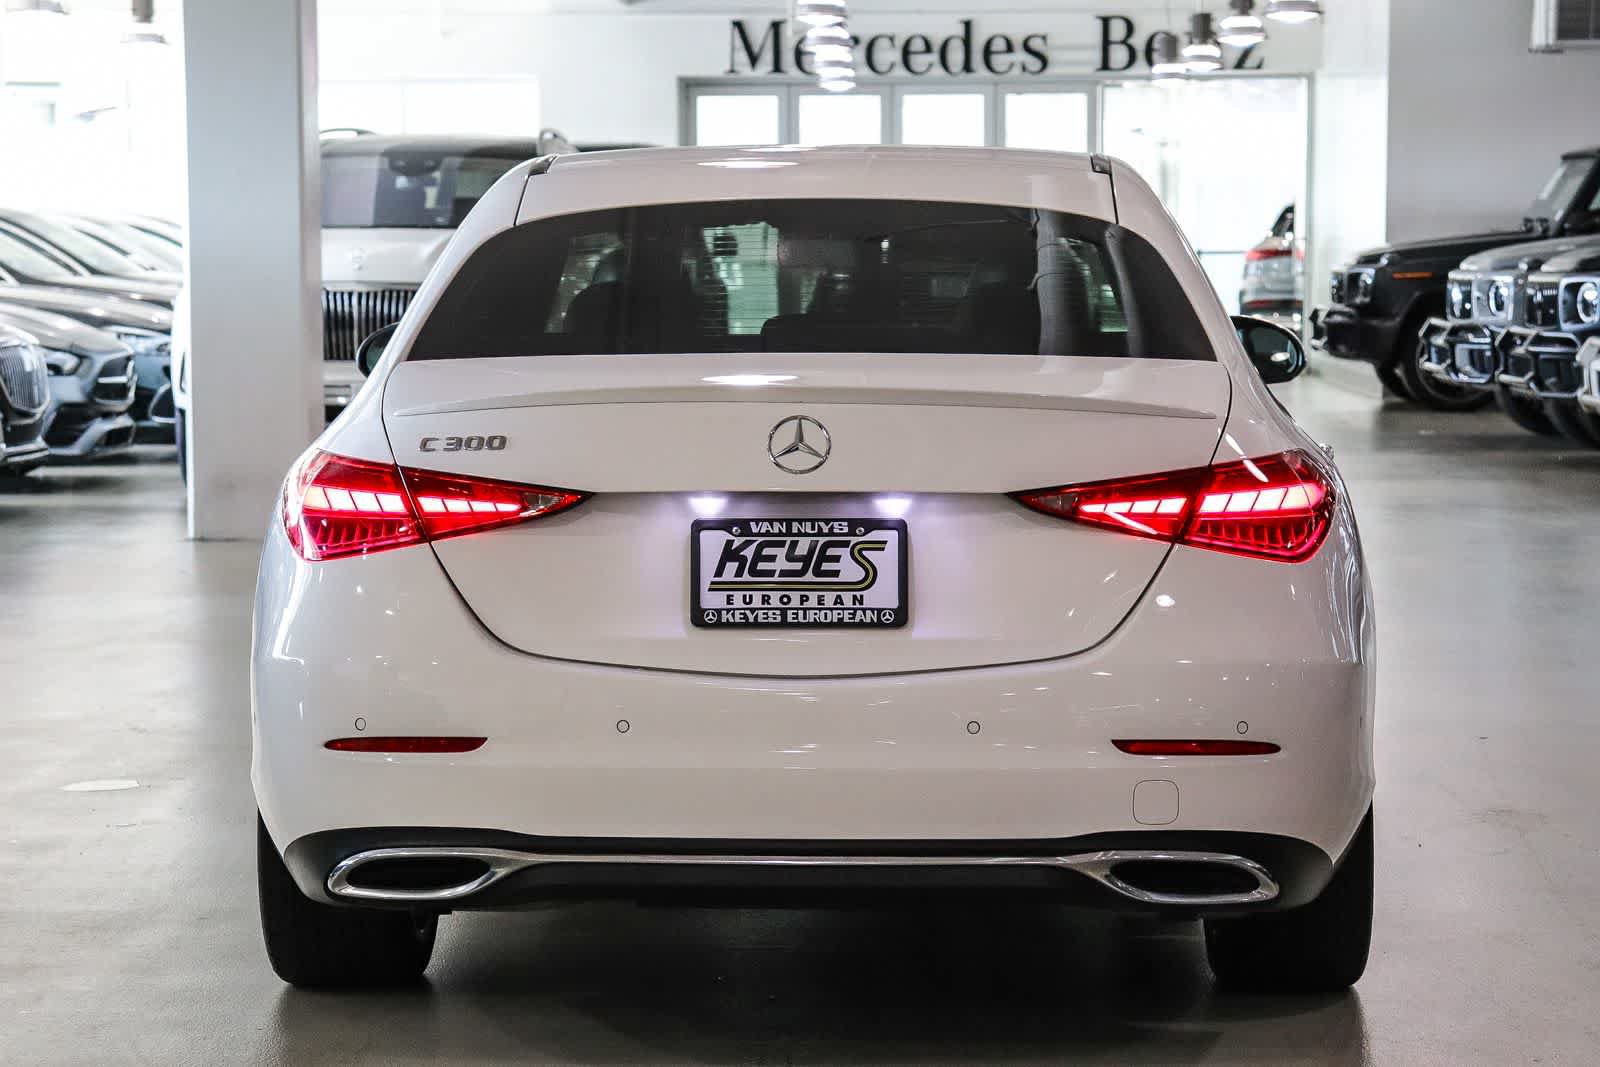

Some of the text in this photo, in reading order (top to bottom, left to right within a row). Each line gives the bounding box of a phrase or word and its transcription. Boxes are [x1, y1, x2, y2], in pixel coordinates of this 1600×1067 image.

[726, 18, 1048, 75] Mecedes
[750, 521, 849, 534] VAN NUYS
[709, 539, 888, 591] KEYES
[726, 594, 864, 606] EUROPEAN
[721, 609, 878, 623] KEYES EUROPEAN
